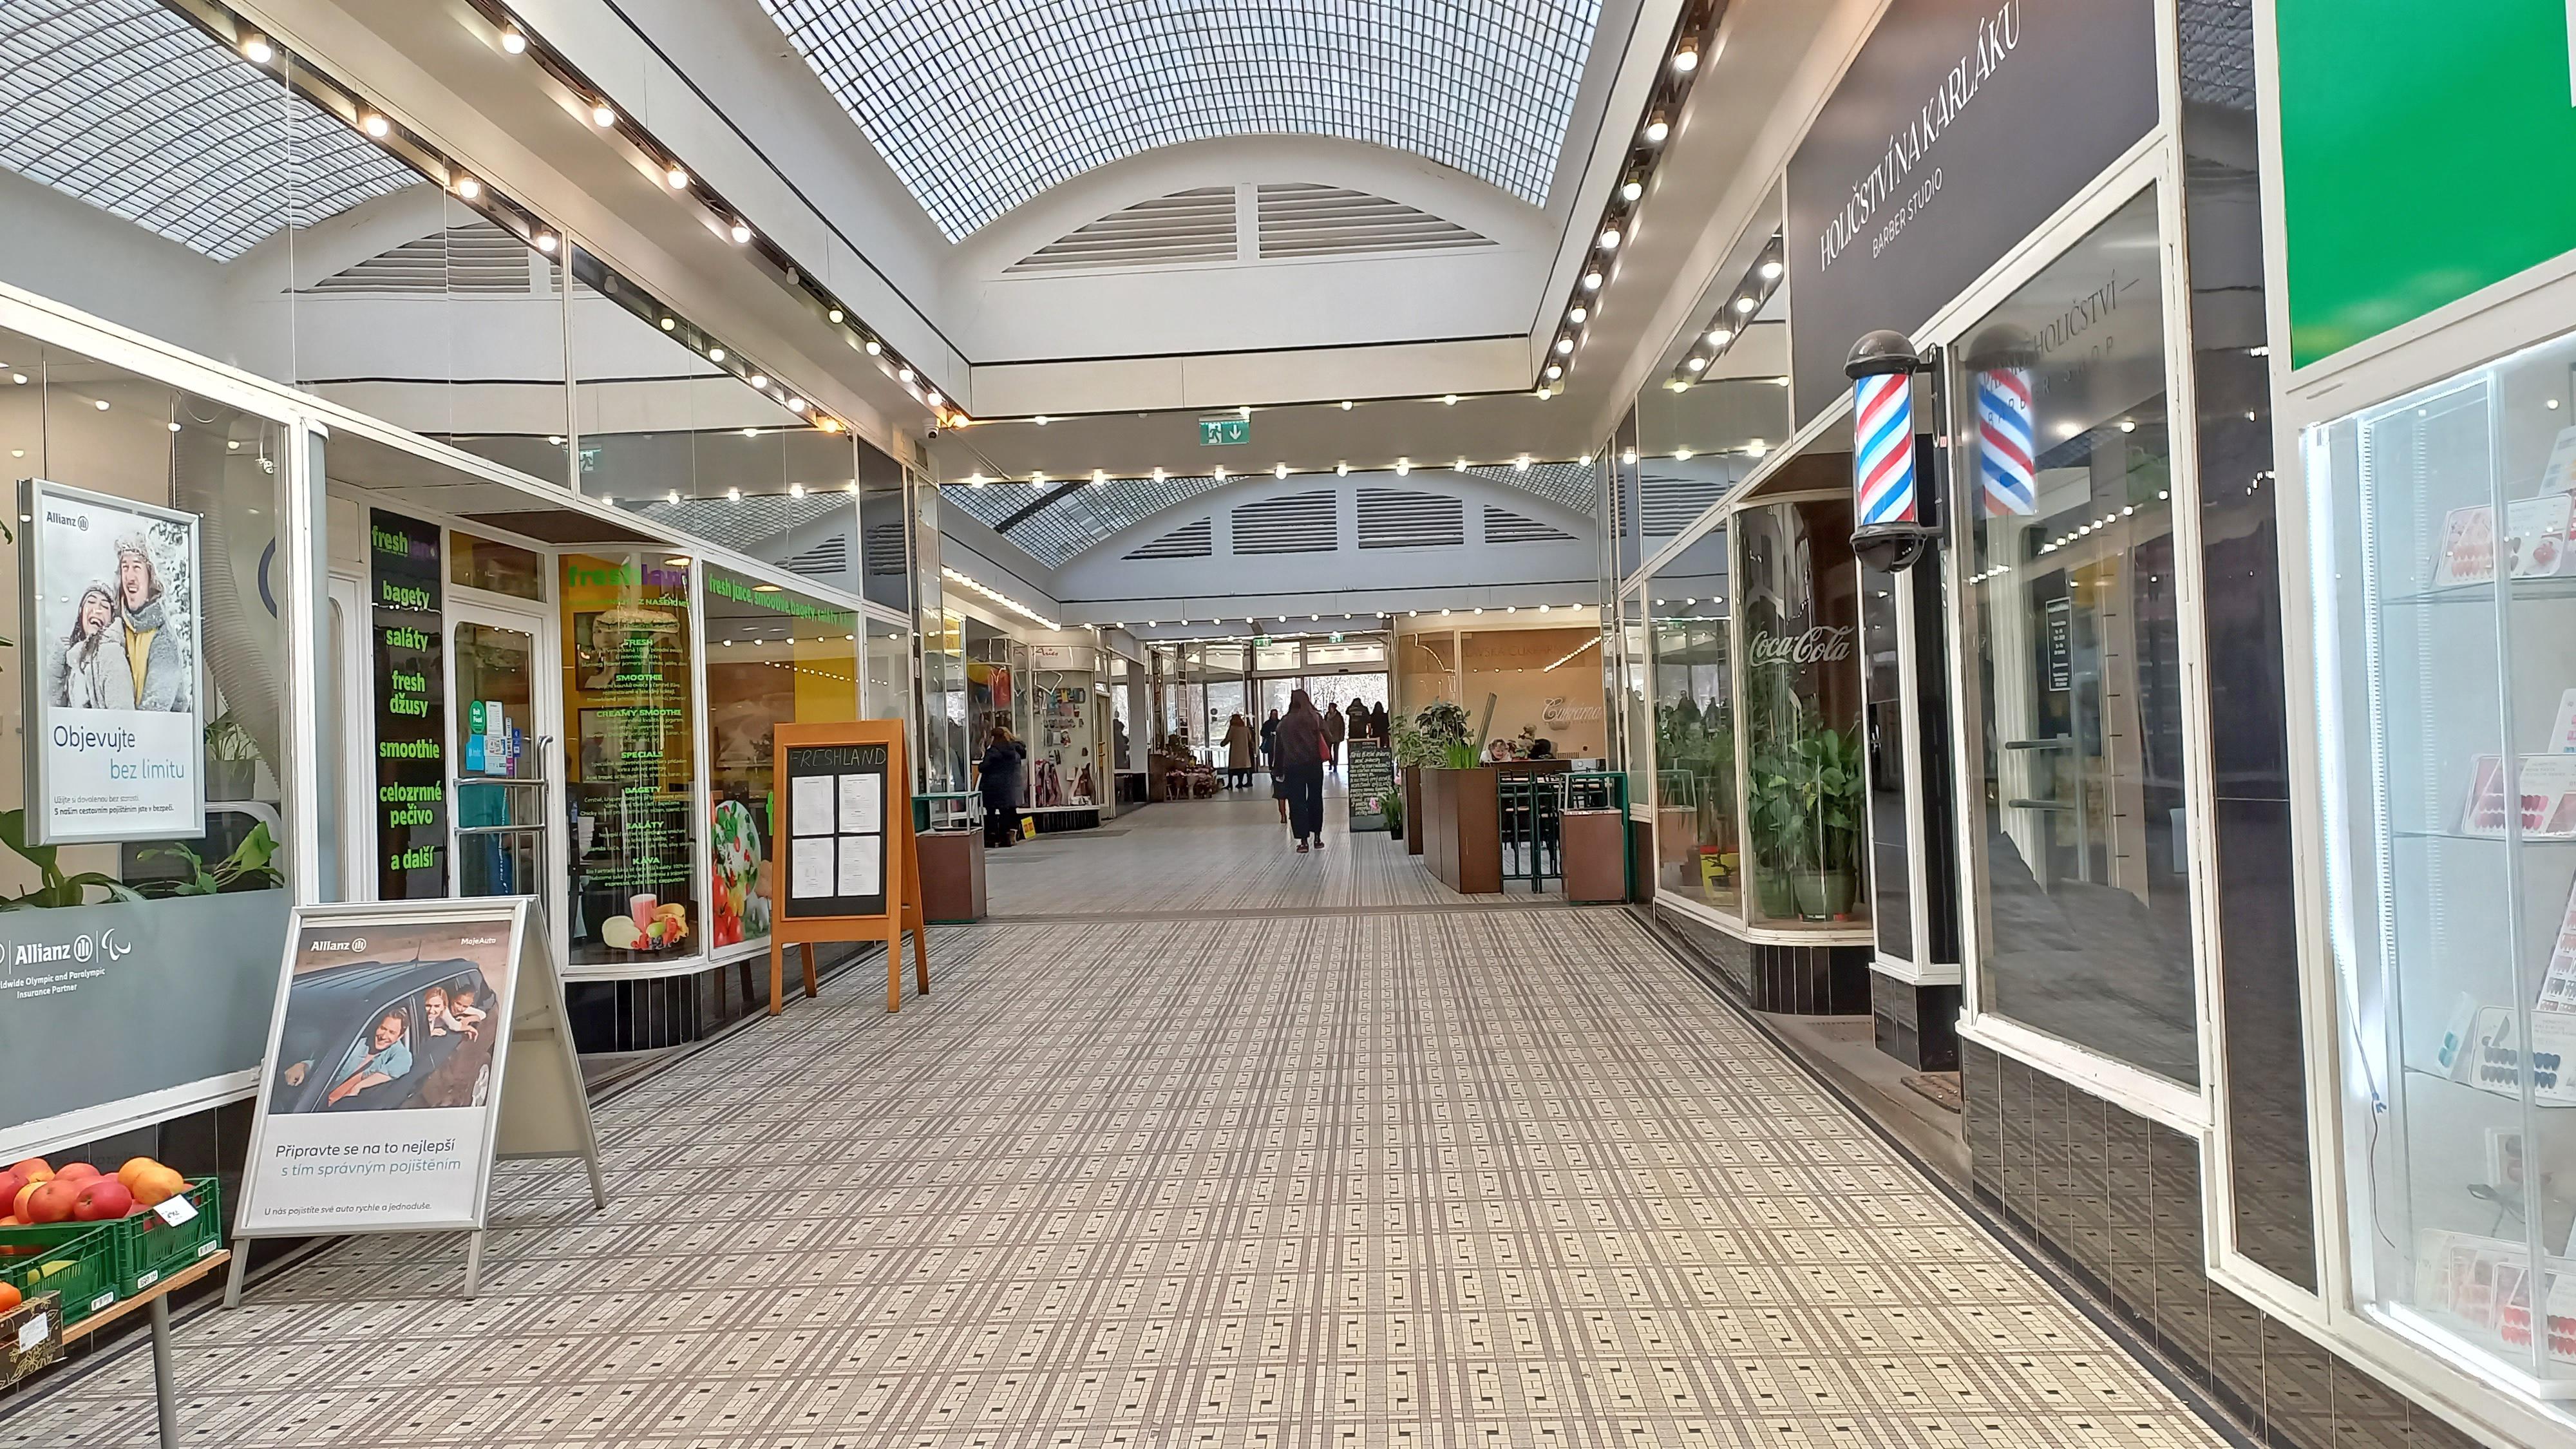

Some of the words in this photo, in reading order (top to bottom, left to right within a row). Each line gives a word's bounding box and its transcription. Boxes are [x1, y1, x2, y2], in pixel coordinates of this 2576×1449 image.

[1820, 134, 1894, 272] HOLIČSTVÍ
[1895, 120, 1921, 185] NA
[1922, 0, 2020, 152] KARLÁKU
[1873, 207, 1906, 258] BARBER
[1908, 167, 1942, 221] STUDIO
[2034, 269, 2116, 355] HOLIČSTVÍ
[46, 511, 77, 527] Allianz
[383, 580, 430, 610] bagety
[708, 573, 732, 598] fresh
[386, 627, 428, 652] saláty
[1749, 625, 1855, 667] Coca-Cola
[392, 670, 426, 692] fresh
[390, 692, 428, 718] džusy
[596, 709, 638, 717] CREAMY
[53, 725, 135, 752] Objevujte
[379, 739, 440, 758] smoothie
[110, 758, 137, 779] bez
[142, 758, 184, 779] limitu
[790, 748, 886, 767] FRESHLAND
[379, 780, 442, 802] celozrnné
[390, 803, 433, 828] pečivo
[626, 820, 664, 829] SALÁTY
[390, 855, 400, 870] a
[402, 845, 435, 869] další
[632, 856, 660, 865] KÁVA
[15, 943, 71, 965] Allianz
[310, 941, 350, 952] Allianz
[25, 974, 54, 986] Olympic
[55, 972, 68, 981] and
[69, 967, 106, 980] Paralympic
[17, 987, 51, 999] Insurance
[52, 984, 77, 994] Partner
[276, 1144, 340, 1159] Připravte
[343, 1145, 359, 1155] se
[363, 1144, 380, 1155] na
[384, 1142, 399, 1153] to
[402, 1139, 456, 1155] nejlepší
[281, 1167, 288, 1176] s
[292, 1164, 314, 1176] tím
[317, 1161, 385, 1177] správným
[390, 1159, 461, 1175] pojištěním
[355, 1204, 380, 1213] rychle
